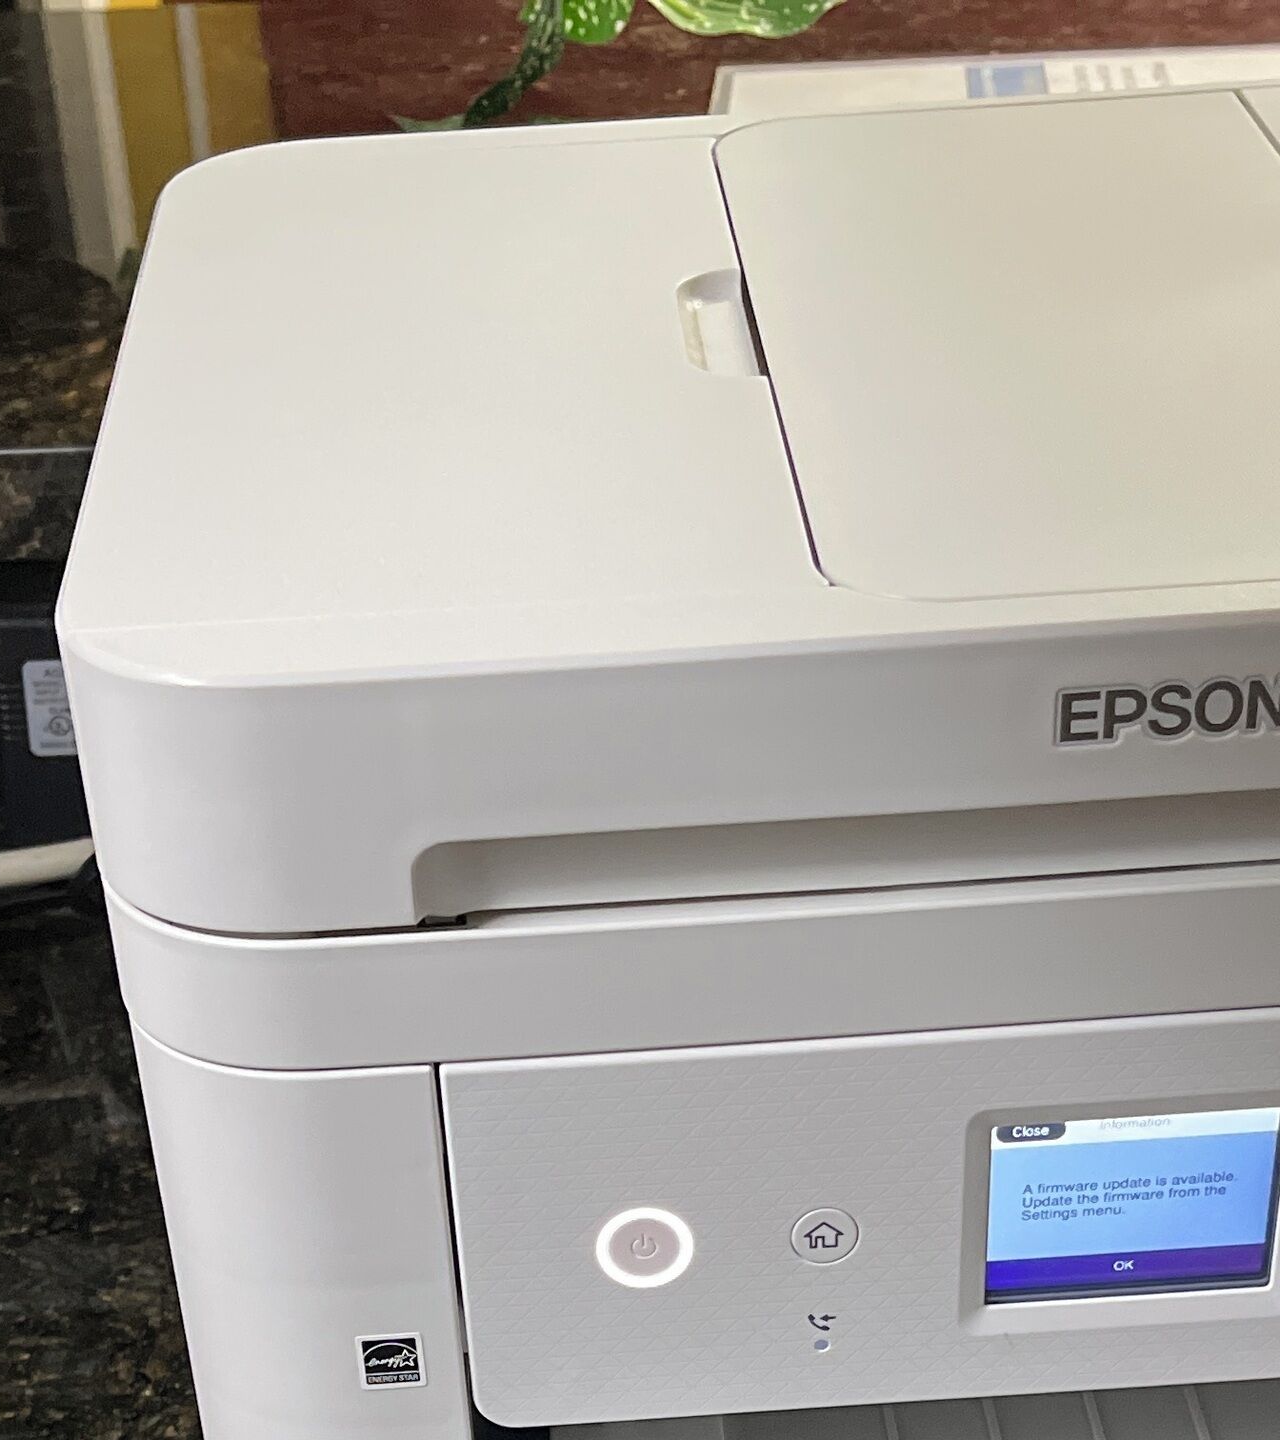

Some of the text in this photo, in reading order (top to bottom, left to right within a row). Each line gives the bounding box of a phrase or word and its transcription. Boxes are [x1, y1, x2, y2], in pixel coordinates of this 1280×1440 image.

[1100, 1117, 1171, 1130] Information
[1012, 1126, 1050, 1138] Close
[1022, 1171, 1239, 1195] A firmware update is available.
[1022, 1184, 1227, 1210] Update the firmware from the
[1021, 1205, 1126, 1222] Settings menu.
[1113, 1260, 1134, 1272] OK
[368, 1373, 419, 1384] ENERGY STAR
